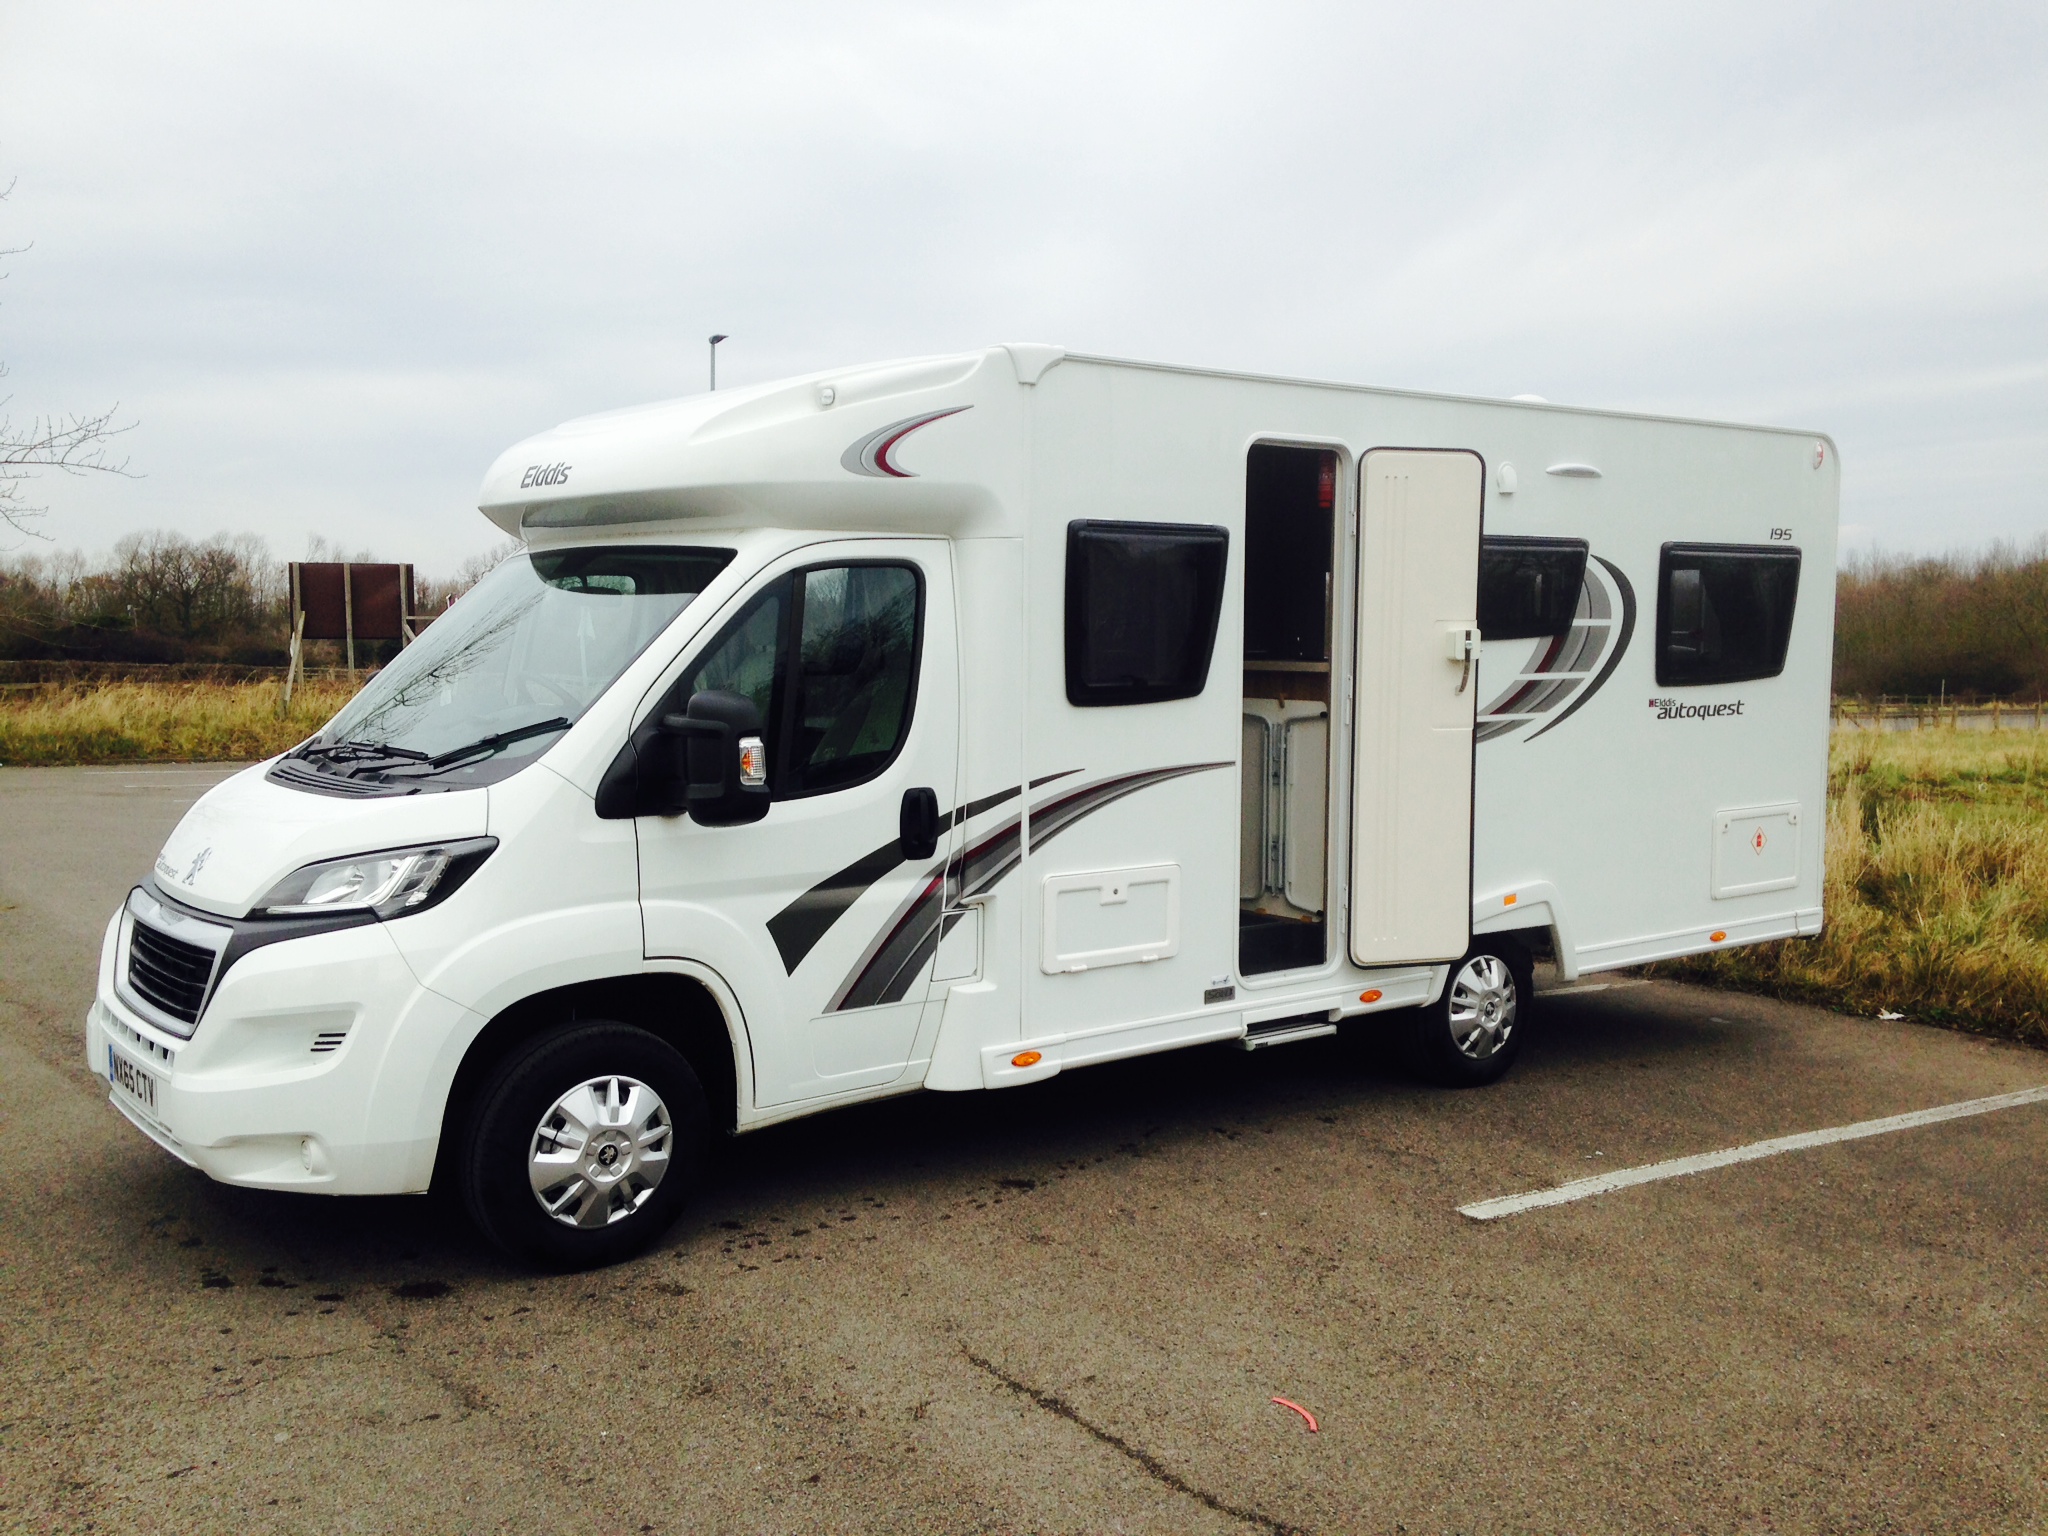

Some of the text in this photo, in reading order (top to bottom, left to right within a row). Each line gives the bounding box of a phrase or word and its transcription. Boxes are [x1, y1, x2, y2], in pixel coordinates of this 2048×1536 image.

[520, 462, 572, 488] Elddis
[1770, 528, 1792, 540] 195
[1654, 698, 1676, 707] Elddis
[1657, 700, 1745, 720] autoquest
